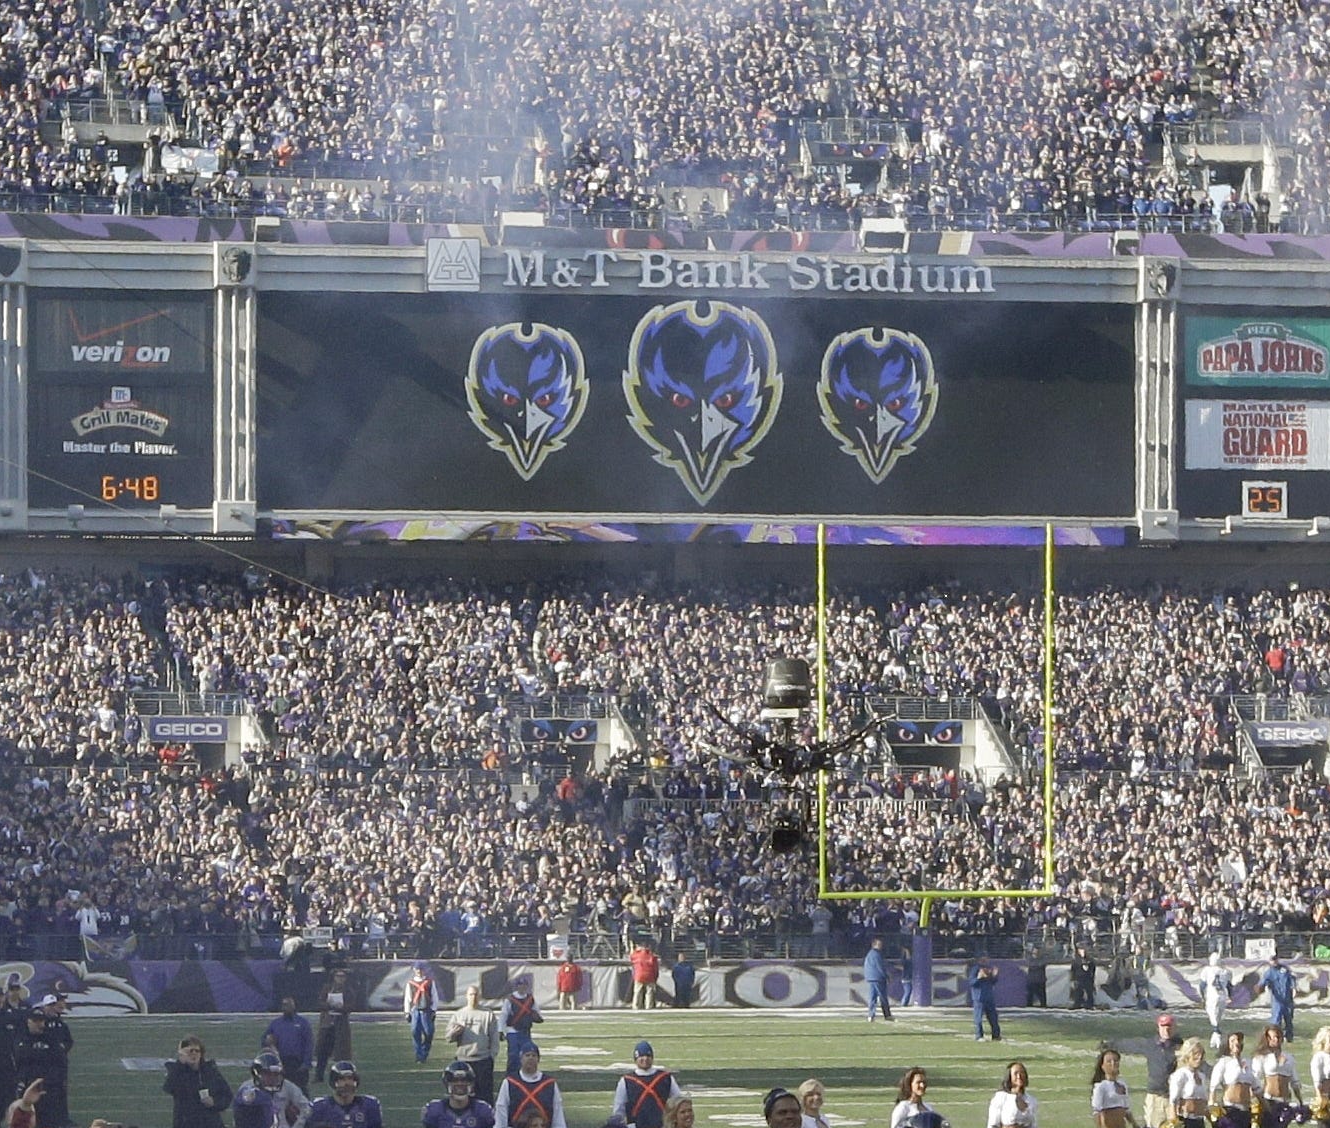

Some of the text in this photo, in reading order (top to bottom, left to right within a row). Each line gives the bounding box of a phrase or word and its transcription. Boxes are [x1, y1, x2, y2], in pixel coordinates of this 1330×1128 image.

[503, 248, 996, 294] M&T Bank Stadium
[71, 341, 171, 367] verizon
[1201, 341, 1321, 373] PAPA JOHNS
[76, 409, 162, 432] Grill Mates
[1222, 412, 1288, 428] NATIONAL
[62, 440, 104, 454] Master
[108, 441, 129, 454] the
[1222, 427, 1308, 456] GUARD
[100, 475, 158, 501] 6:48
[1249, 488, 1278, 513] 25
[154, 722, 223, 738] GEICO
[1257, 726, 1328, 742] GEICO
